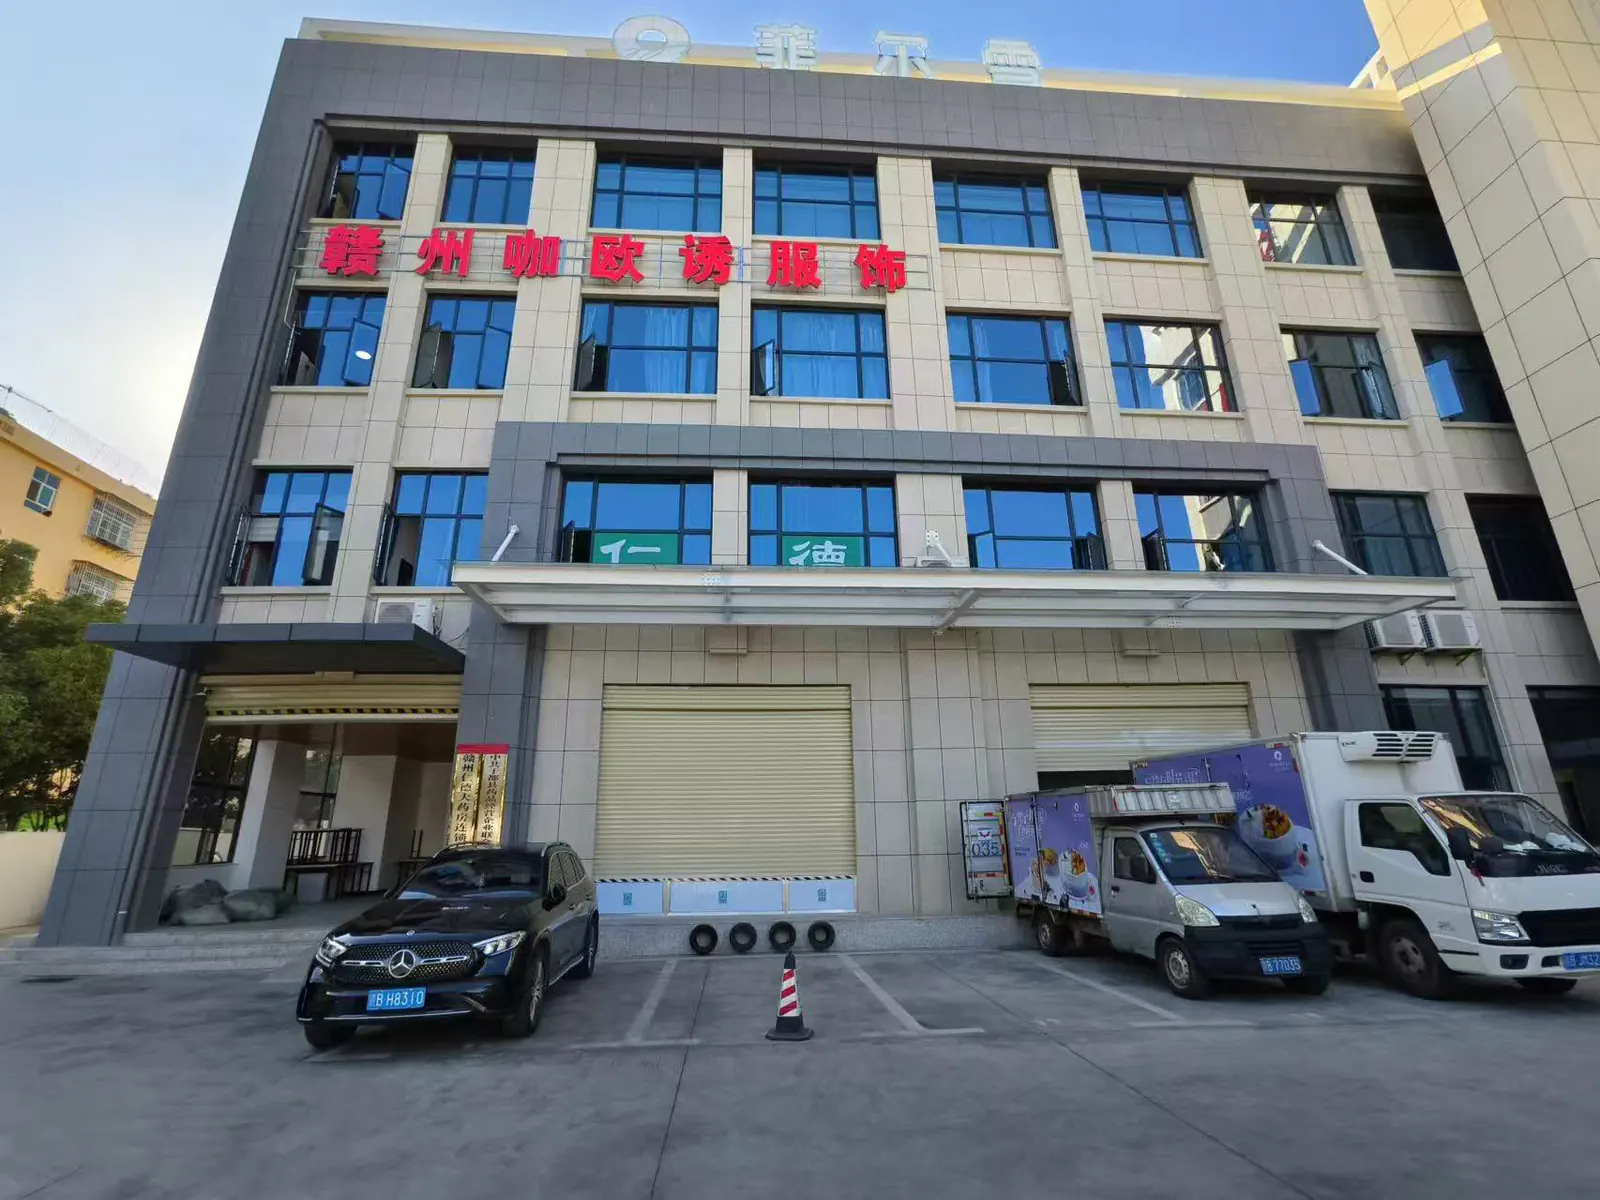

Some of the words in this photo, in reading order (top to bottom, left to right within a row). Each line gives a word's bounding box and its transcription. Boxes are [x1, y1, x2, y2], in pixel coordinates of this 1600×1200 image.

[319, 224, 907, 293] 赣州咖欧诱服饰
